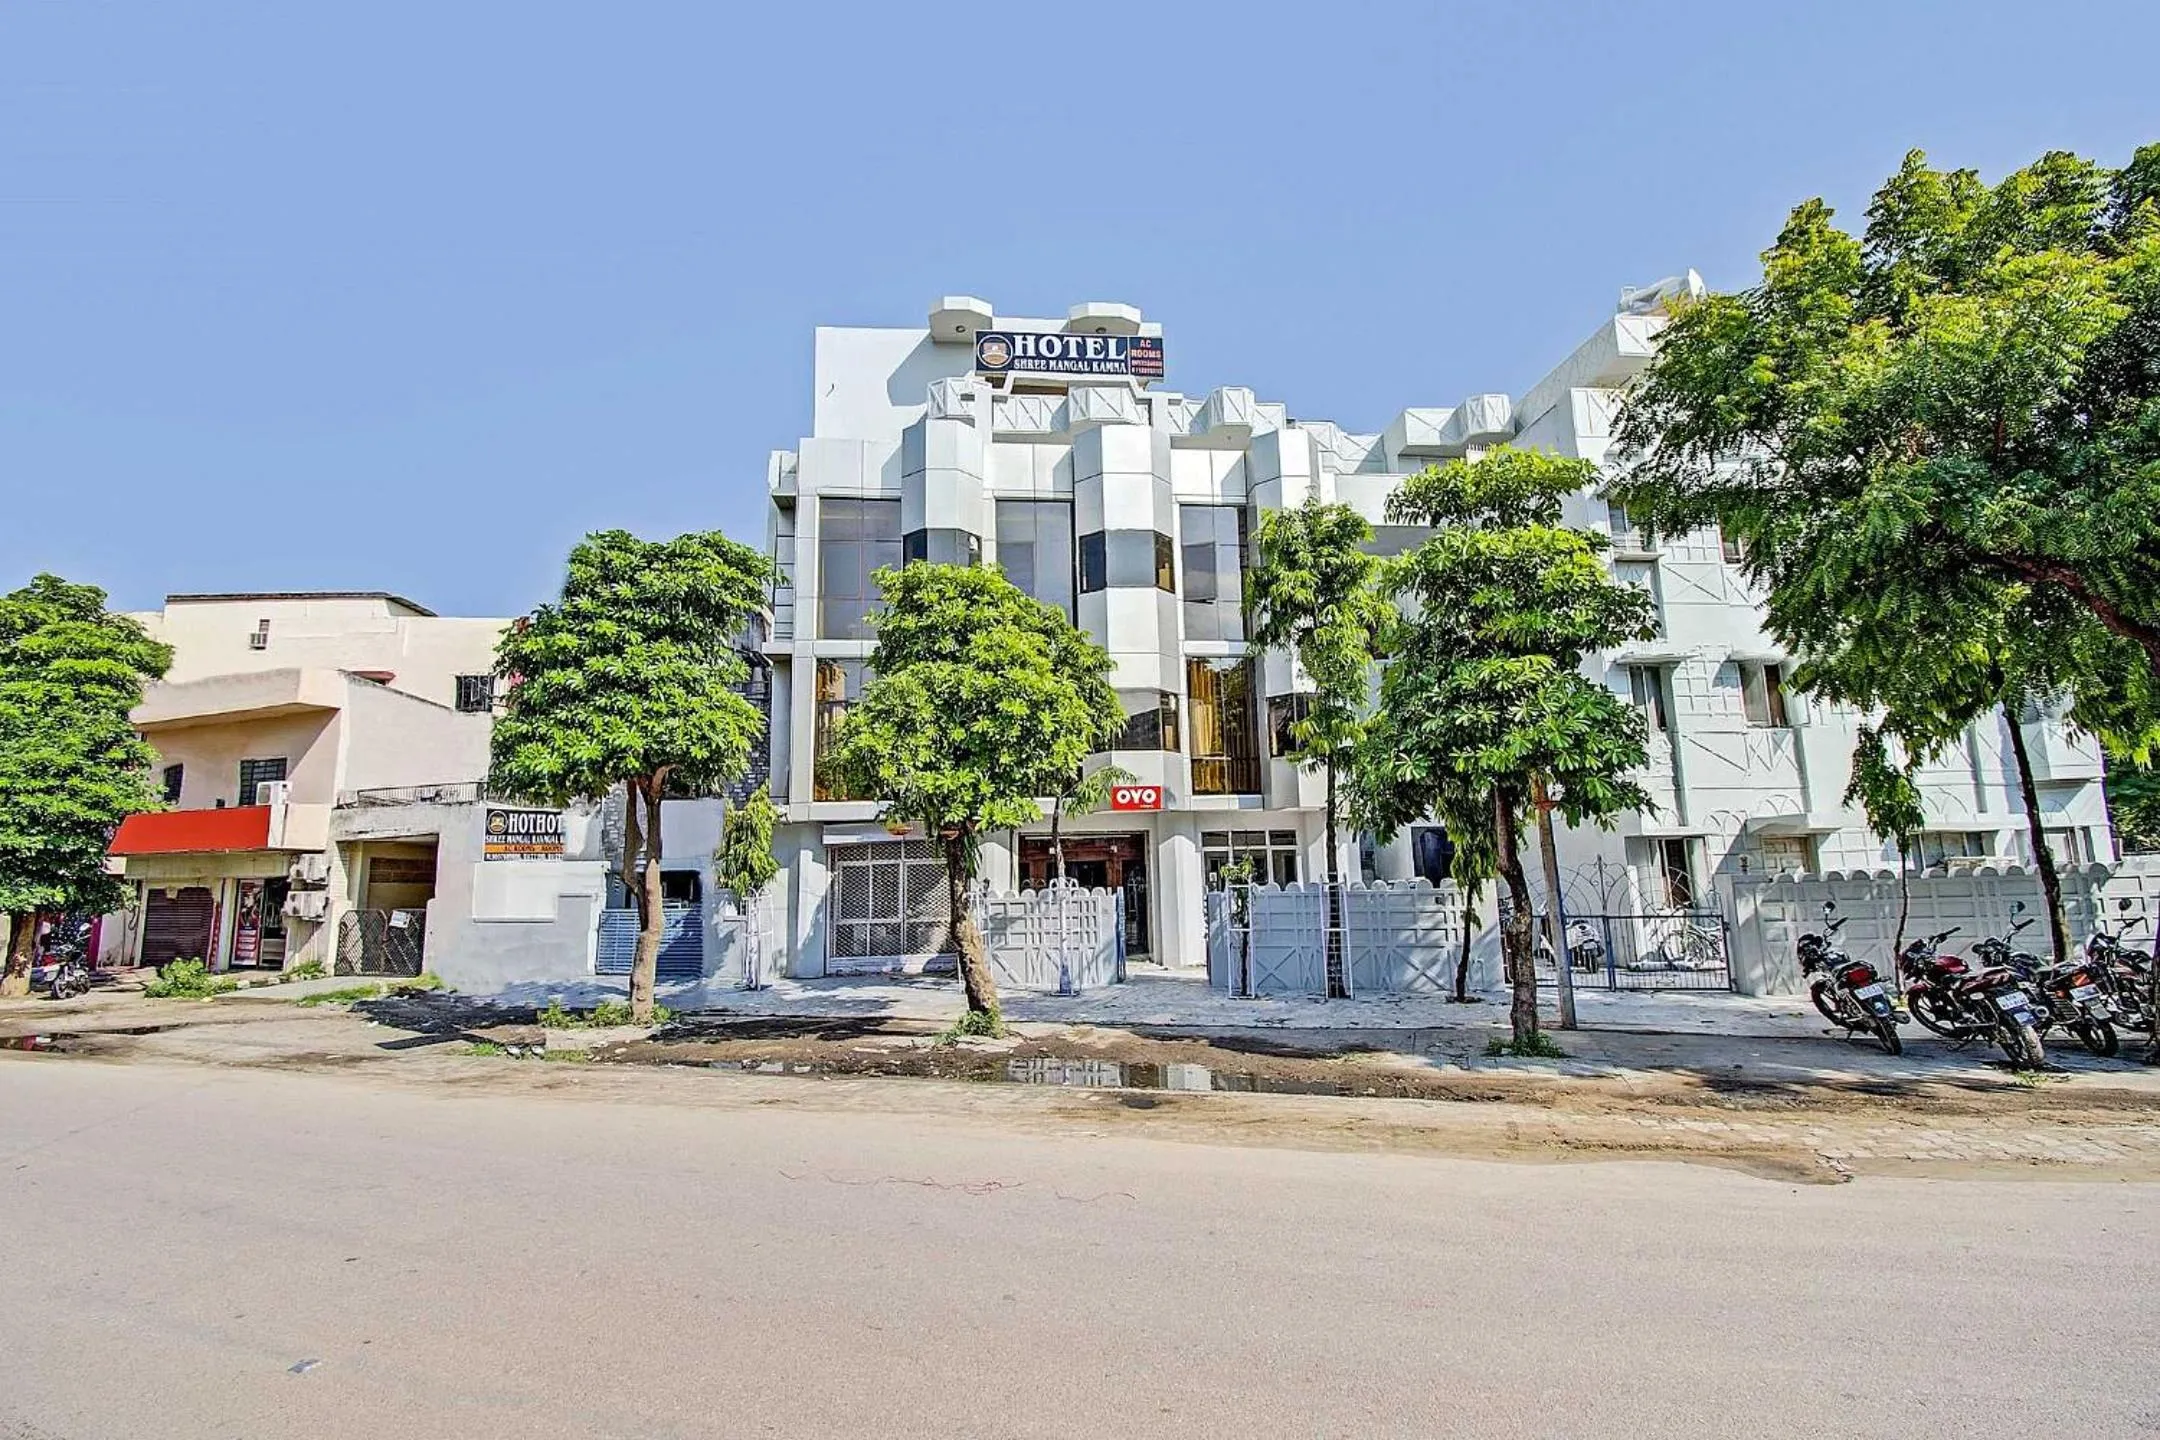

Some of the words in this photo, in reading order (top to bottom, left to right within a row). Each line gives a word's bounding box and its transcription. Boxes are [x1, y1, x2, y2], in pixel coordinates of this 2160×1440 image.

[1013, 334, 1126, 360] HOTEL
[1140, 339, 1152, 348] AC
[1131, 349, 1161, 359] ROOMS
[1014, 358, 1047, 370] SHREE
[1049, 359, 1090, 372] MANGAL
[1116, 788, 1157, 804] OYO
